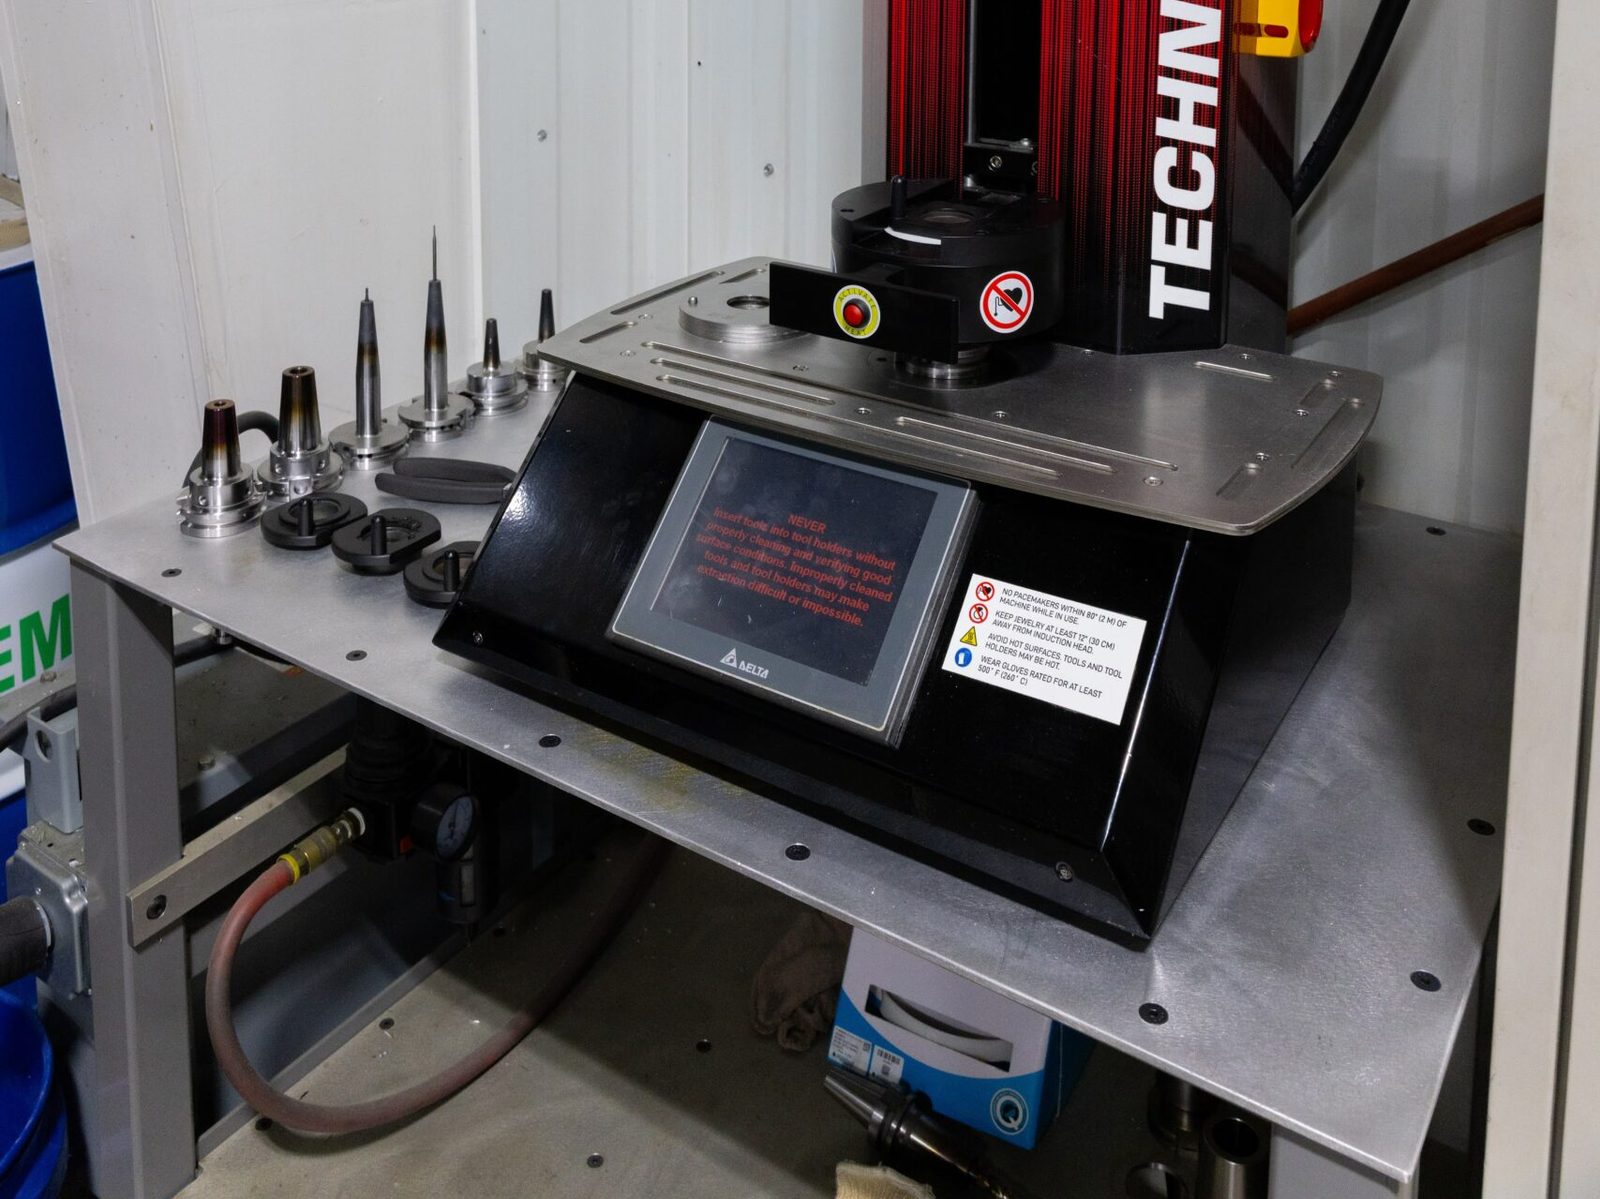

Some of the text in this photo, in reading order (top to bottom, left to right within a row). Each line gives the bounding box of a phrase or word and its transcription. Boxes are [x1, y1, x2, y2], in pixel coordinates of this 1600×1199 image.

[713, 507, 895, 569] Insert tools into tool holders without
[787, 515, 826, 532] NEVER
[695, 533, 892, 602] surface conditions. Improperly cleaned
[706, 521, 891, 585] properly cleaning and verifying good
[696, 564, 864, 626] extraction difficult or impossible.
[703, 551, 869, 612] tools and tool holders may make
[999, 597, 1079, 624] MACHINE WHILE IN USE.
[1002, 588, 1012, 596] NO
[1013, 591, 1059, 609] PACEMAKERS
[1060, 604, 1085, 616] WITHIN
[1098, 614, 1105, 622] (2
[1106, 617, 1116, 625] M)
[1116, 620, 1126, 628] OF
[992, 619, 1094, 654] AWAY FROM INDUCTION HEAD.
[995, 610, 1014, 620] KEEP
[1014, 615, 1044, 629] JEWELRY
[1045, 624, 1054, 632] AT
[1054, 627, 1077, 639] LEAST
[1088, 637, 1099, 645] (30
[1100, 640, 1115, 650] CM)
[985, 641, 1060, 669] HOLDERS MAY BE HOT.
[988, 632, 1123, 678] AVOID HOT SURFACES. TOOLS AND TOOL
[980, 655, 1102, 698] WEAR GLOVES RATED FOR AT LEAST
[1019, 677, 1028, 686] C)
